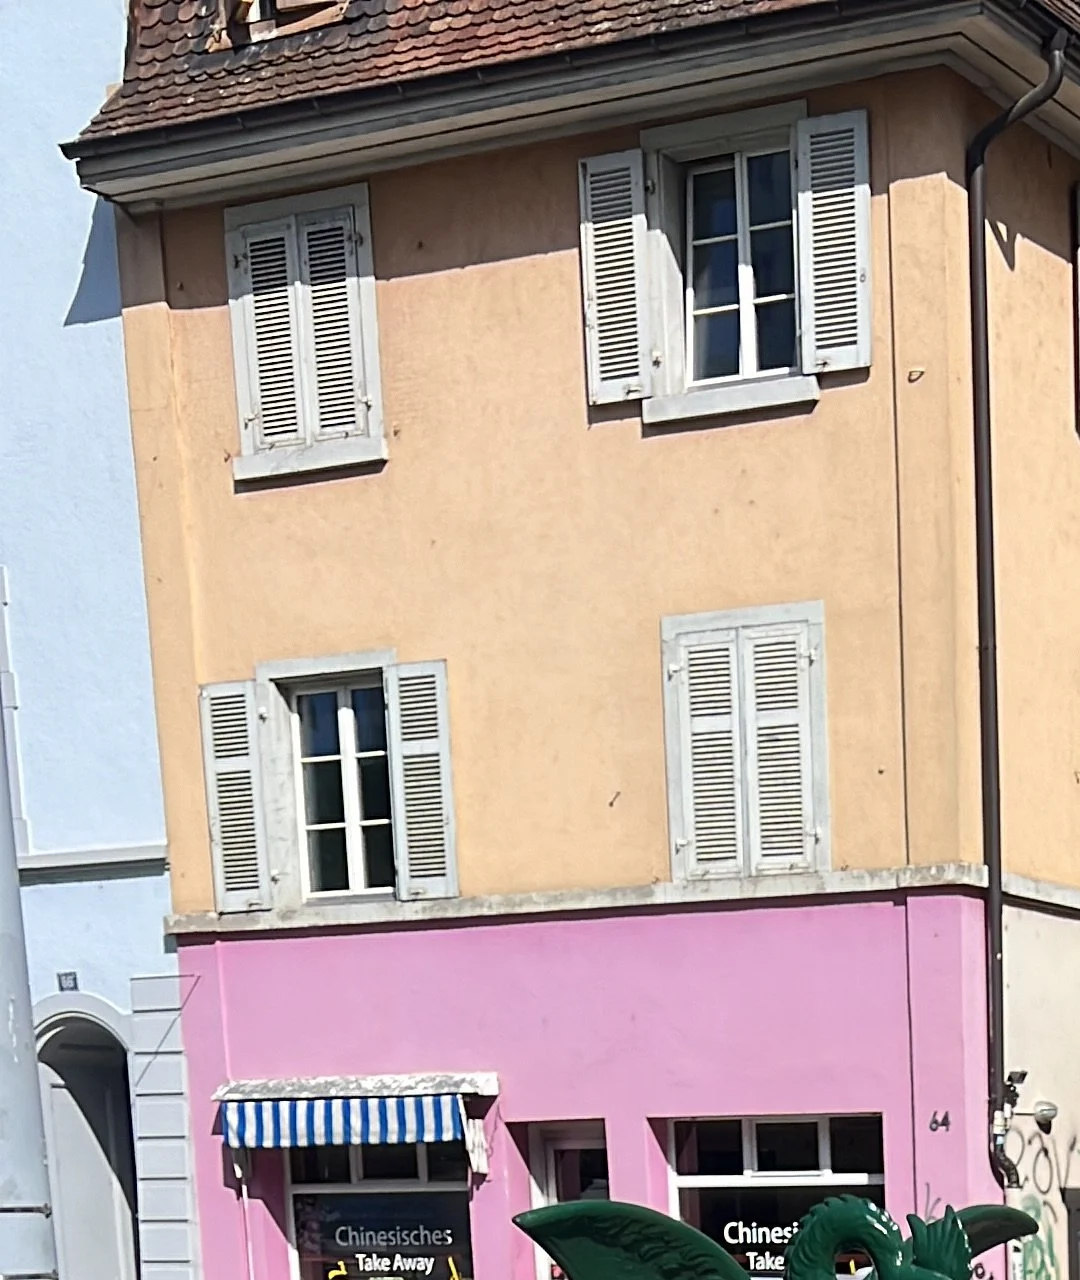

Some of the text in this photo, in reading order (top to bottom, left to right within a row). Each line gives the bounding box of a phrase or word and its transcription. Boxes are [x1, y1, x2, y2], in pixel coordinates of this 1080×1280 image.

[929, 1110, 951, 1132] 64
[335, 1225, 452, 1246] Chinesisches
[723, 1221, 799, 1244] Chinesi
[355, 1253, 435, 1275] Take Away
[745, 1251, 785, 1270] Take
